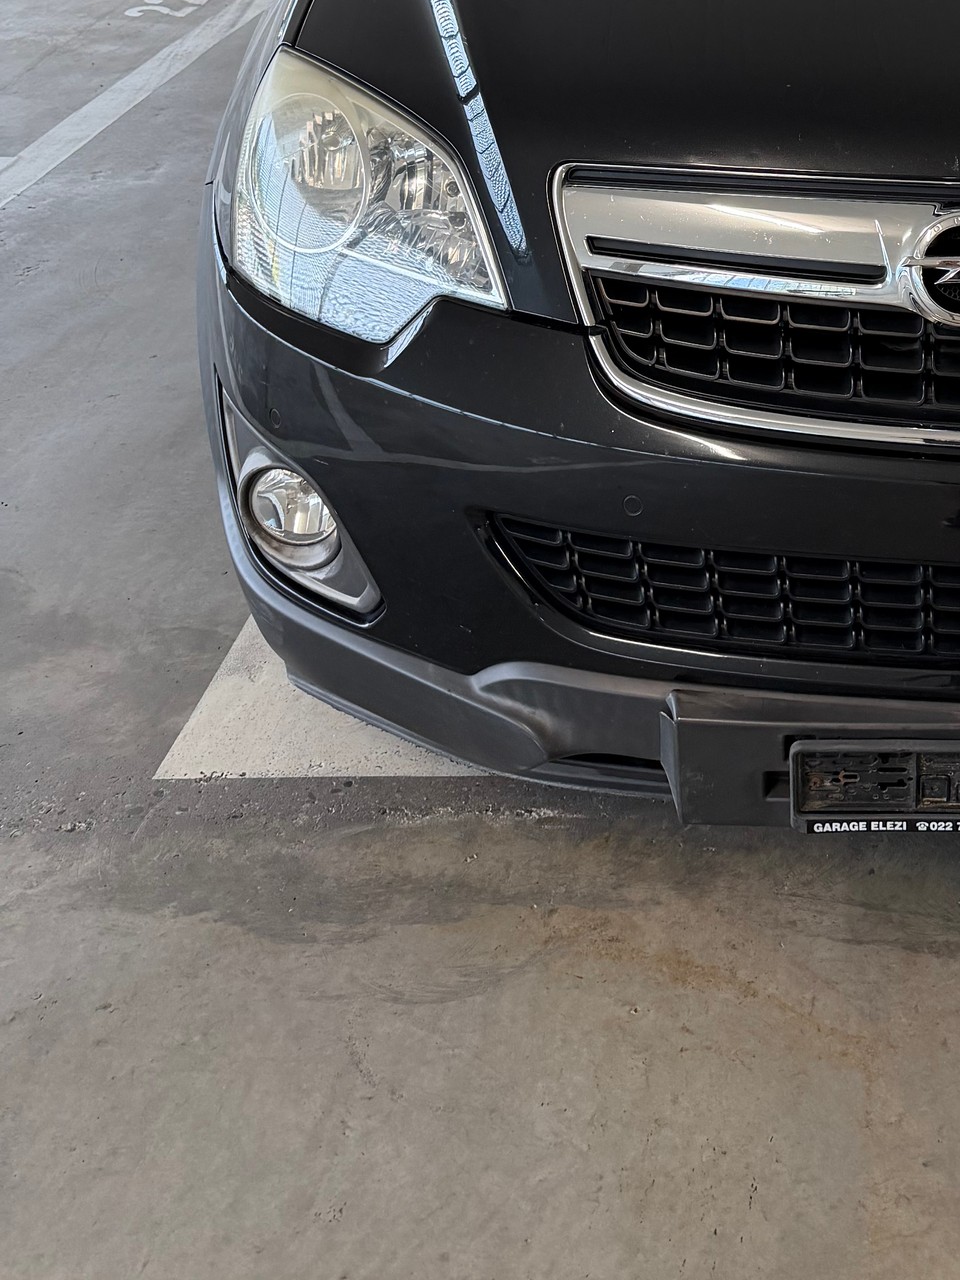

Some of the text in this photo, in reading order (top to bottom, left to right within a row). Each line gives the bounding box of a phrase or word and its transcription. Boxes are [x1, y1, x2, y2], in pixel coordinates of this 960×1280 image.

[813, 822, 867, 833] GARAGE
[870, 821, 907, 831] ELEZI
[930, 821, 953, 831] 022
